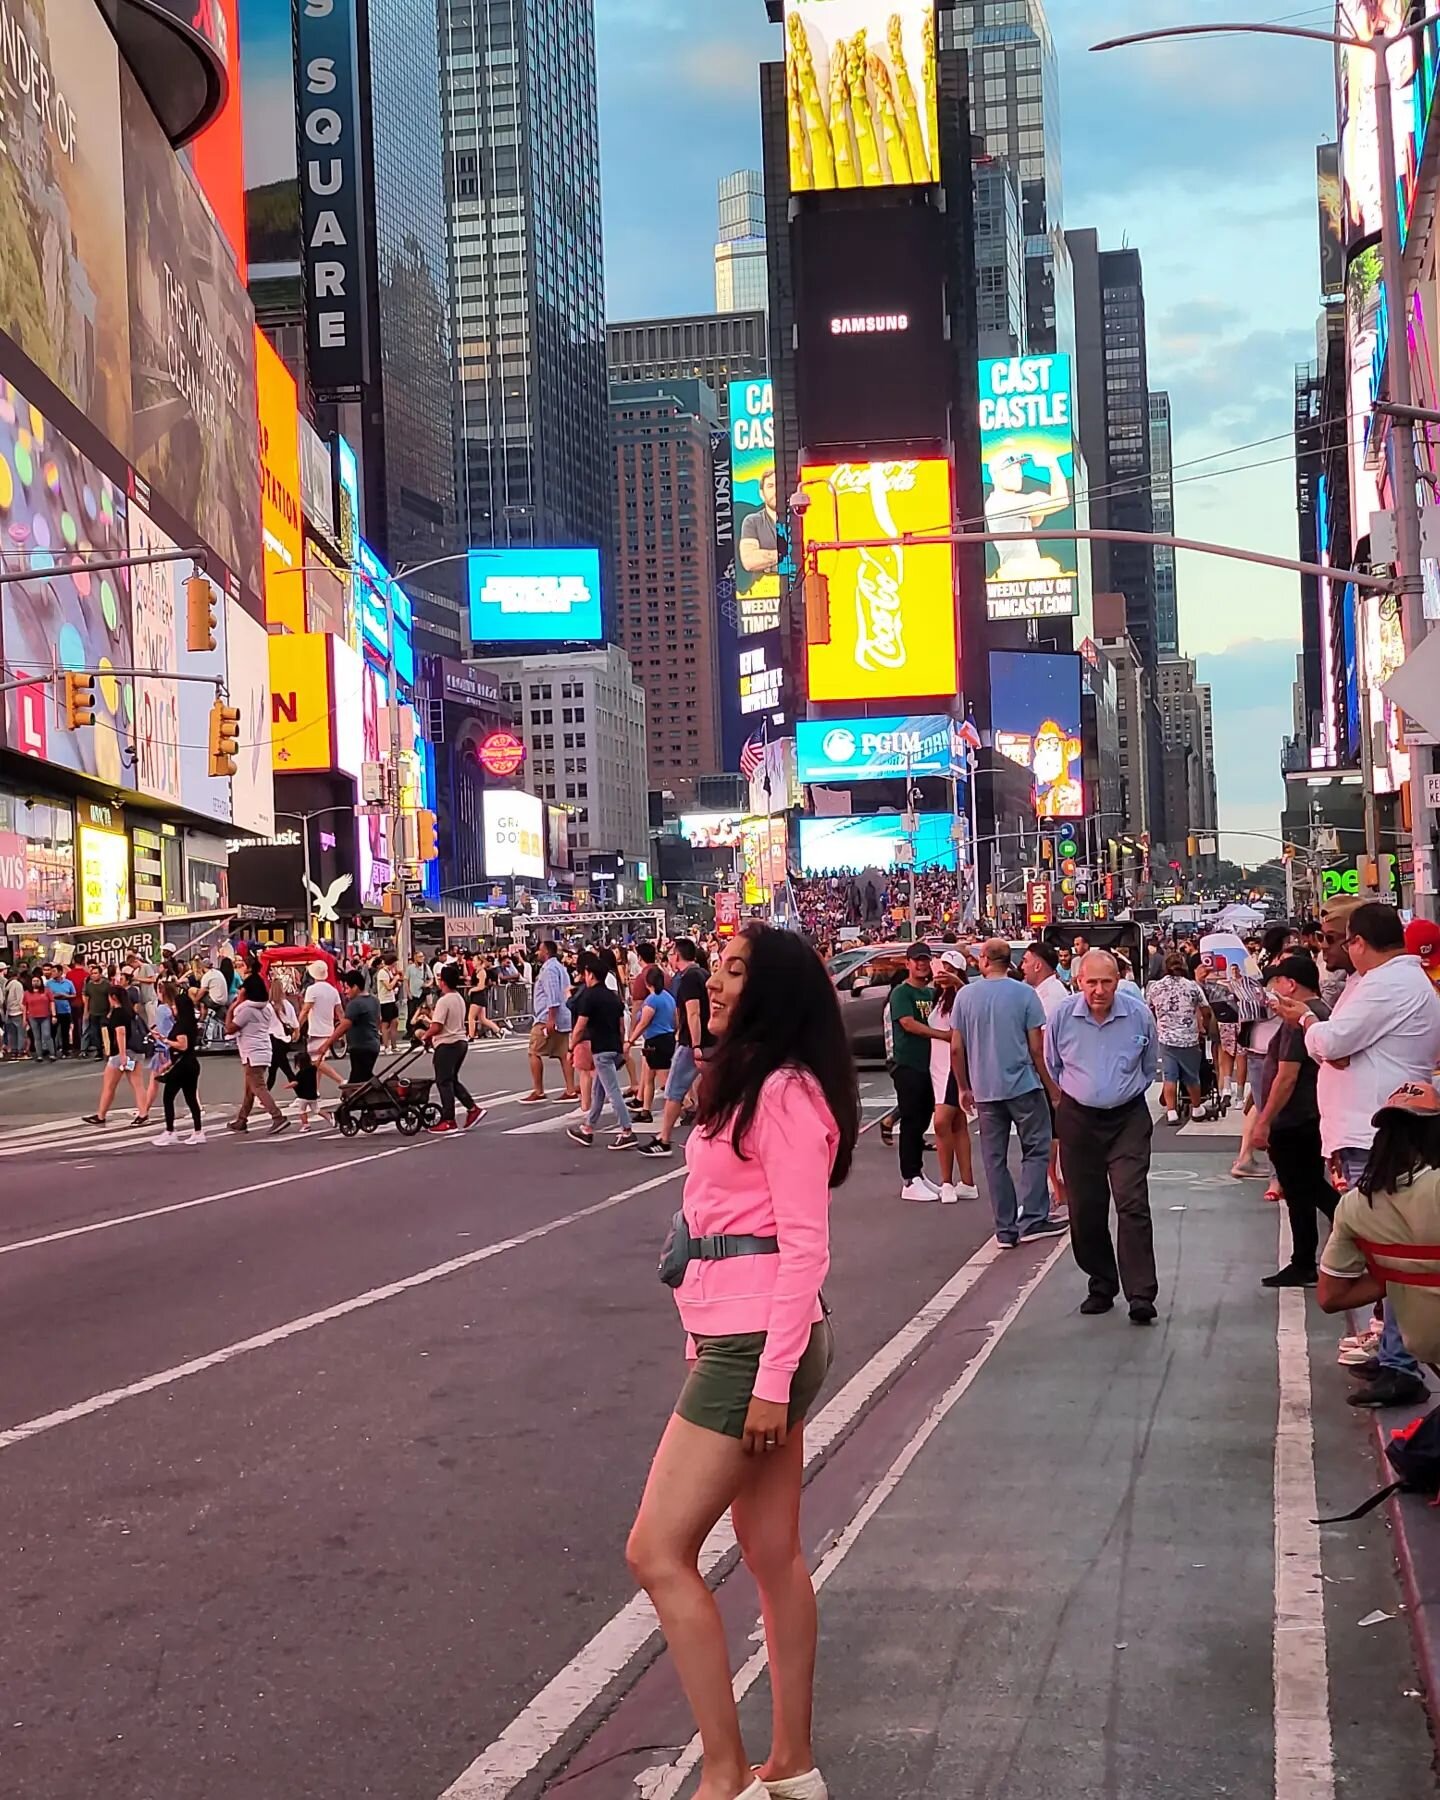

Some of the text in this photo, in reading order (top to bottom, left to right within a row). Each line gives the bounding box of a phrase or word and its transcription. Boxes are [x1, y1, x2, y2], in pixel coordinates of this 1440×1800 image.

[0, 2, 53, 133] NDER
[56, 92, 77, 164] OF
[305, 58, 347, 348] SQUARE
[164, 261, 237, 409] THE WONDER OF
[831, 314, 908, 334] SAMSUNG
[167, 335, 217, 440] CLEAN AIR
[991, 357, 1054, 395] CAST
[980, 392, 1068, 431] CASTLE
[734, 417, 775, 451] CAS
[987, 578, 1071, 598] WEEKLY ONLY ON
[741, 599, 780, 615] WEEKLY
[987, 596, 1072, 618] TIMCAST.COM
[861, 731, 921, 756] PGIM
[497, 832, 519, 843] DO
[1032, 884, 1047, 913] tkts
[77, 933, 152, 955] DISCOVER
